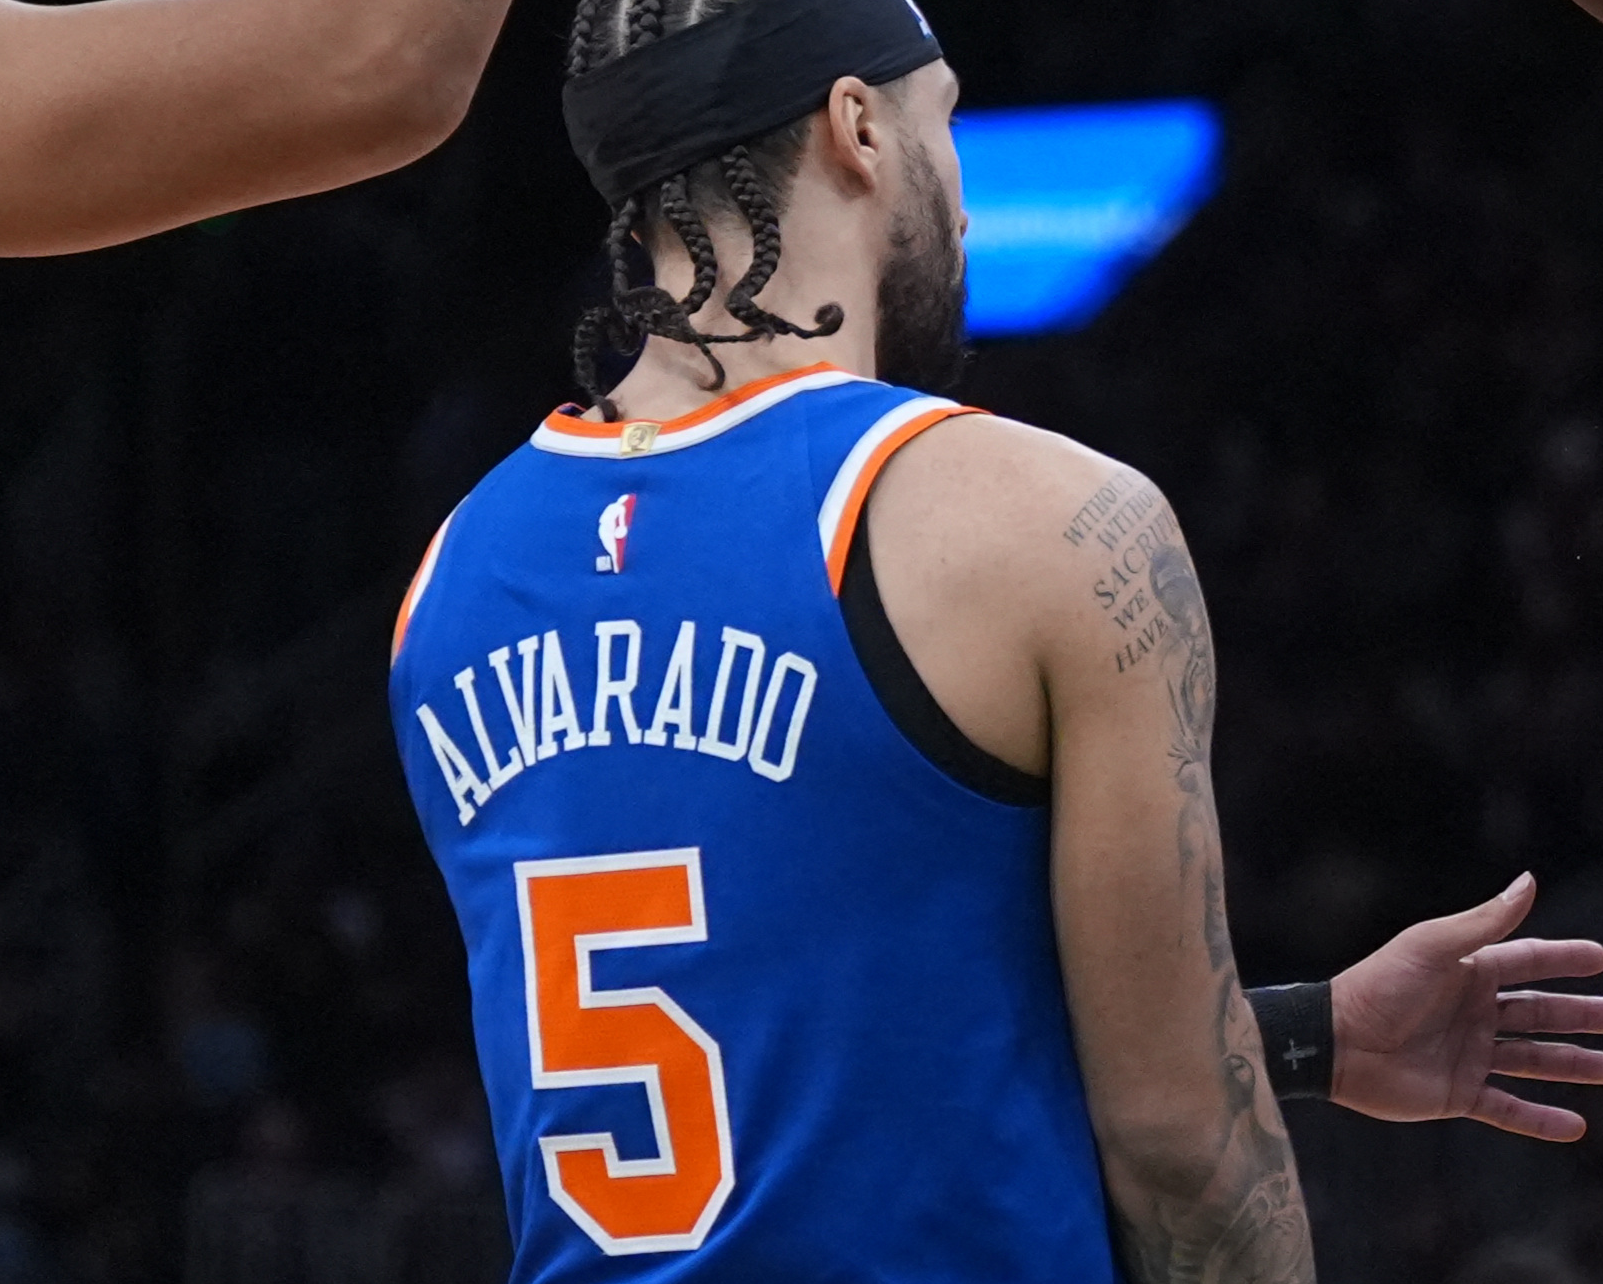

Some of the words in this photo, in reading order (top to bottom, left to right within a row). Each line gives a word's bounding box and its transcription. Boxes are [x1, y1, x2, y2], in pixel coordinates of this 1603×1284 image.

[1113, 588, 1150, 632] WE
[1114, 612, 1169, 674] HAVE
[416, 619, 818, 827] ALVARADO
[514, 847, 736, 1256] 5
